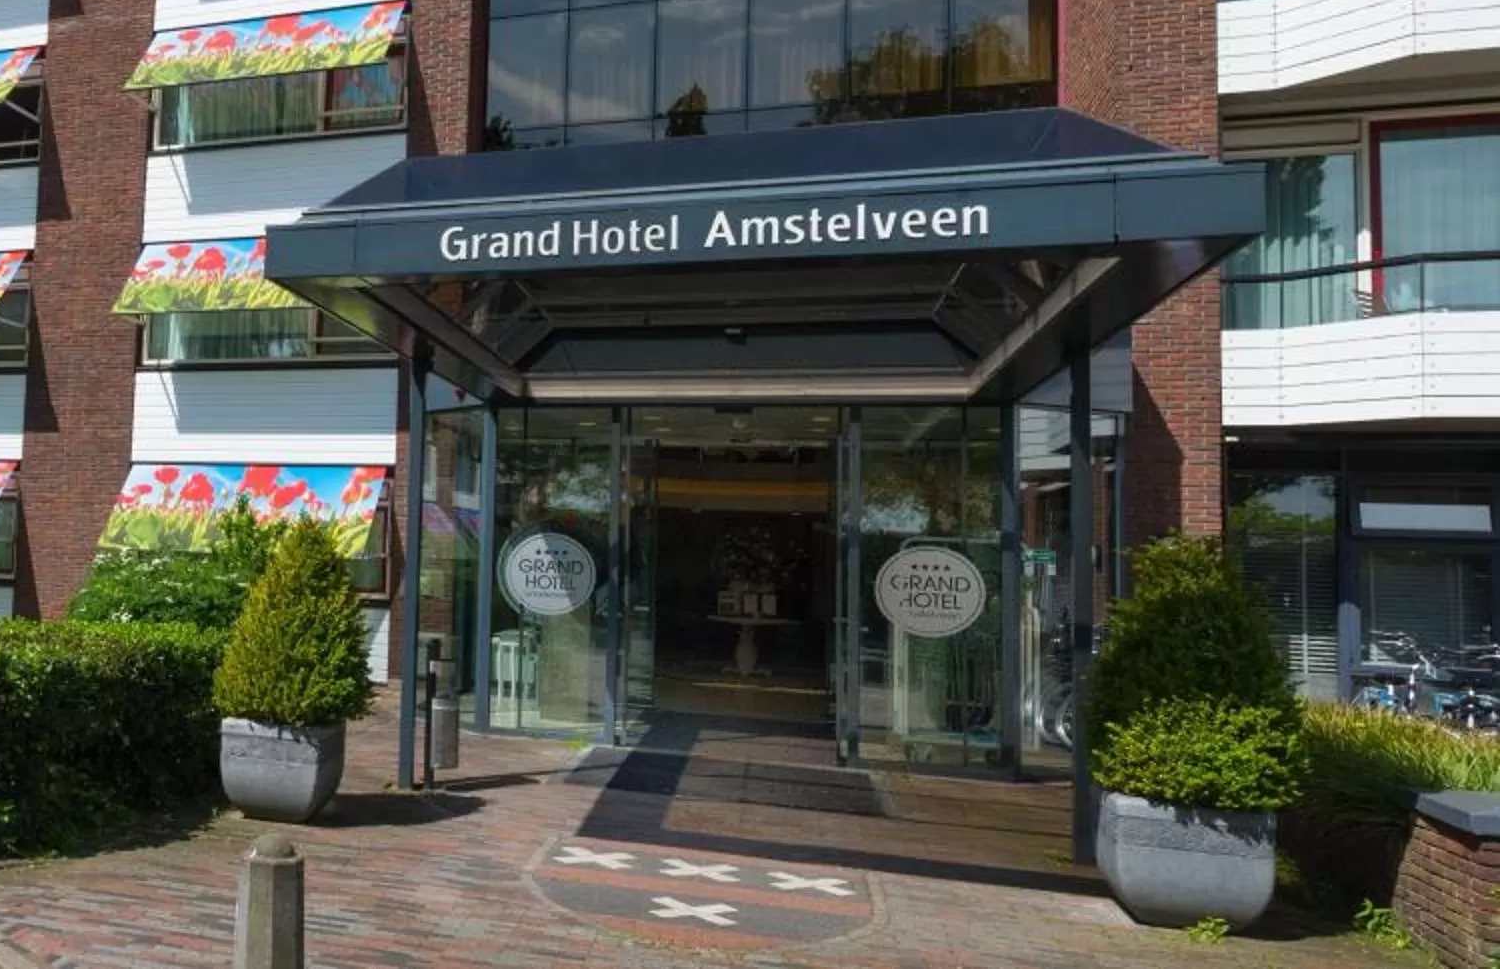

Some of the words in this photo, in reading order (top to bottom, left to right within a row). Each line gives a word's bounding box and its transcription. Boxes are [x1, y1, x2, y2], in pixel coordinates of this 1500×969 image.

[440, 221, 560, 261] Grand
[573, 215, 679, 256] Hotel
[703, 203, 989, 247] Amstelveen
[518, 558, 584, 576] GRAND
[525, 574, 576, 590] HOTEL
[891, 574, 971, 593] GRAND
